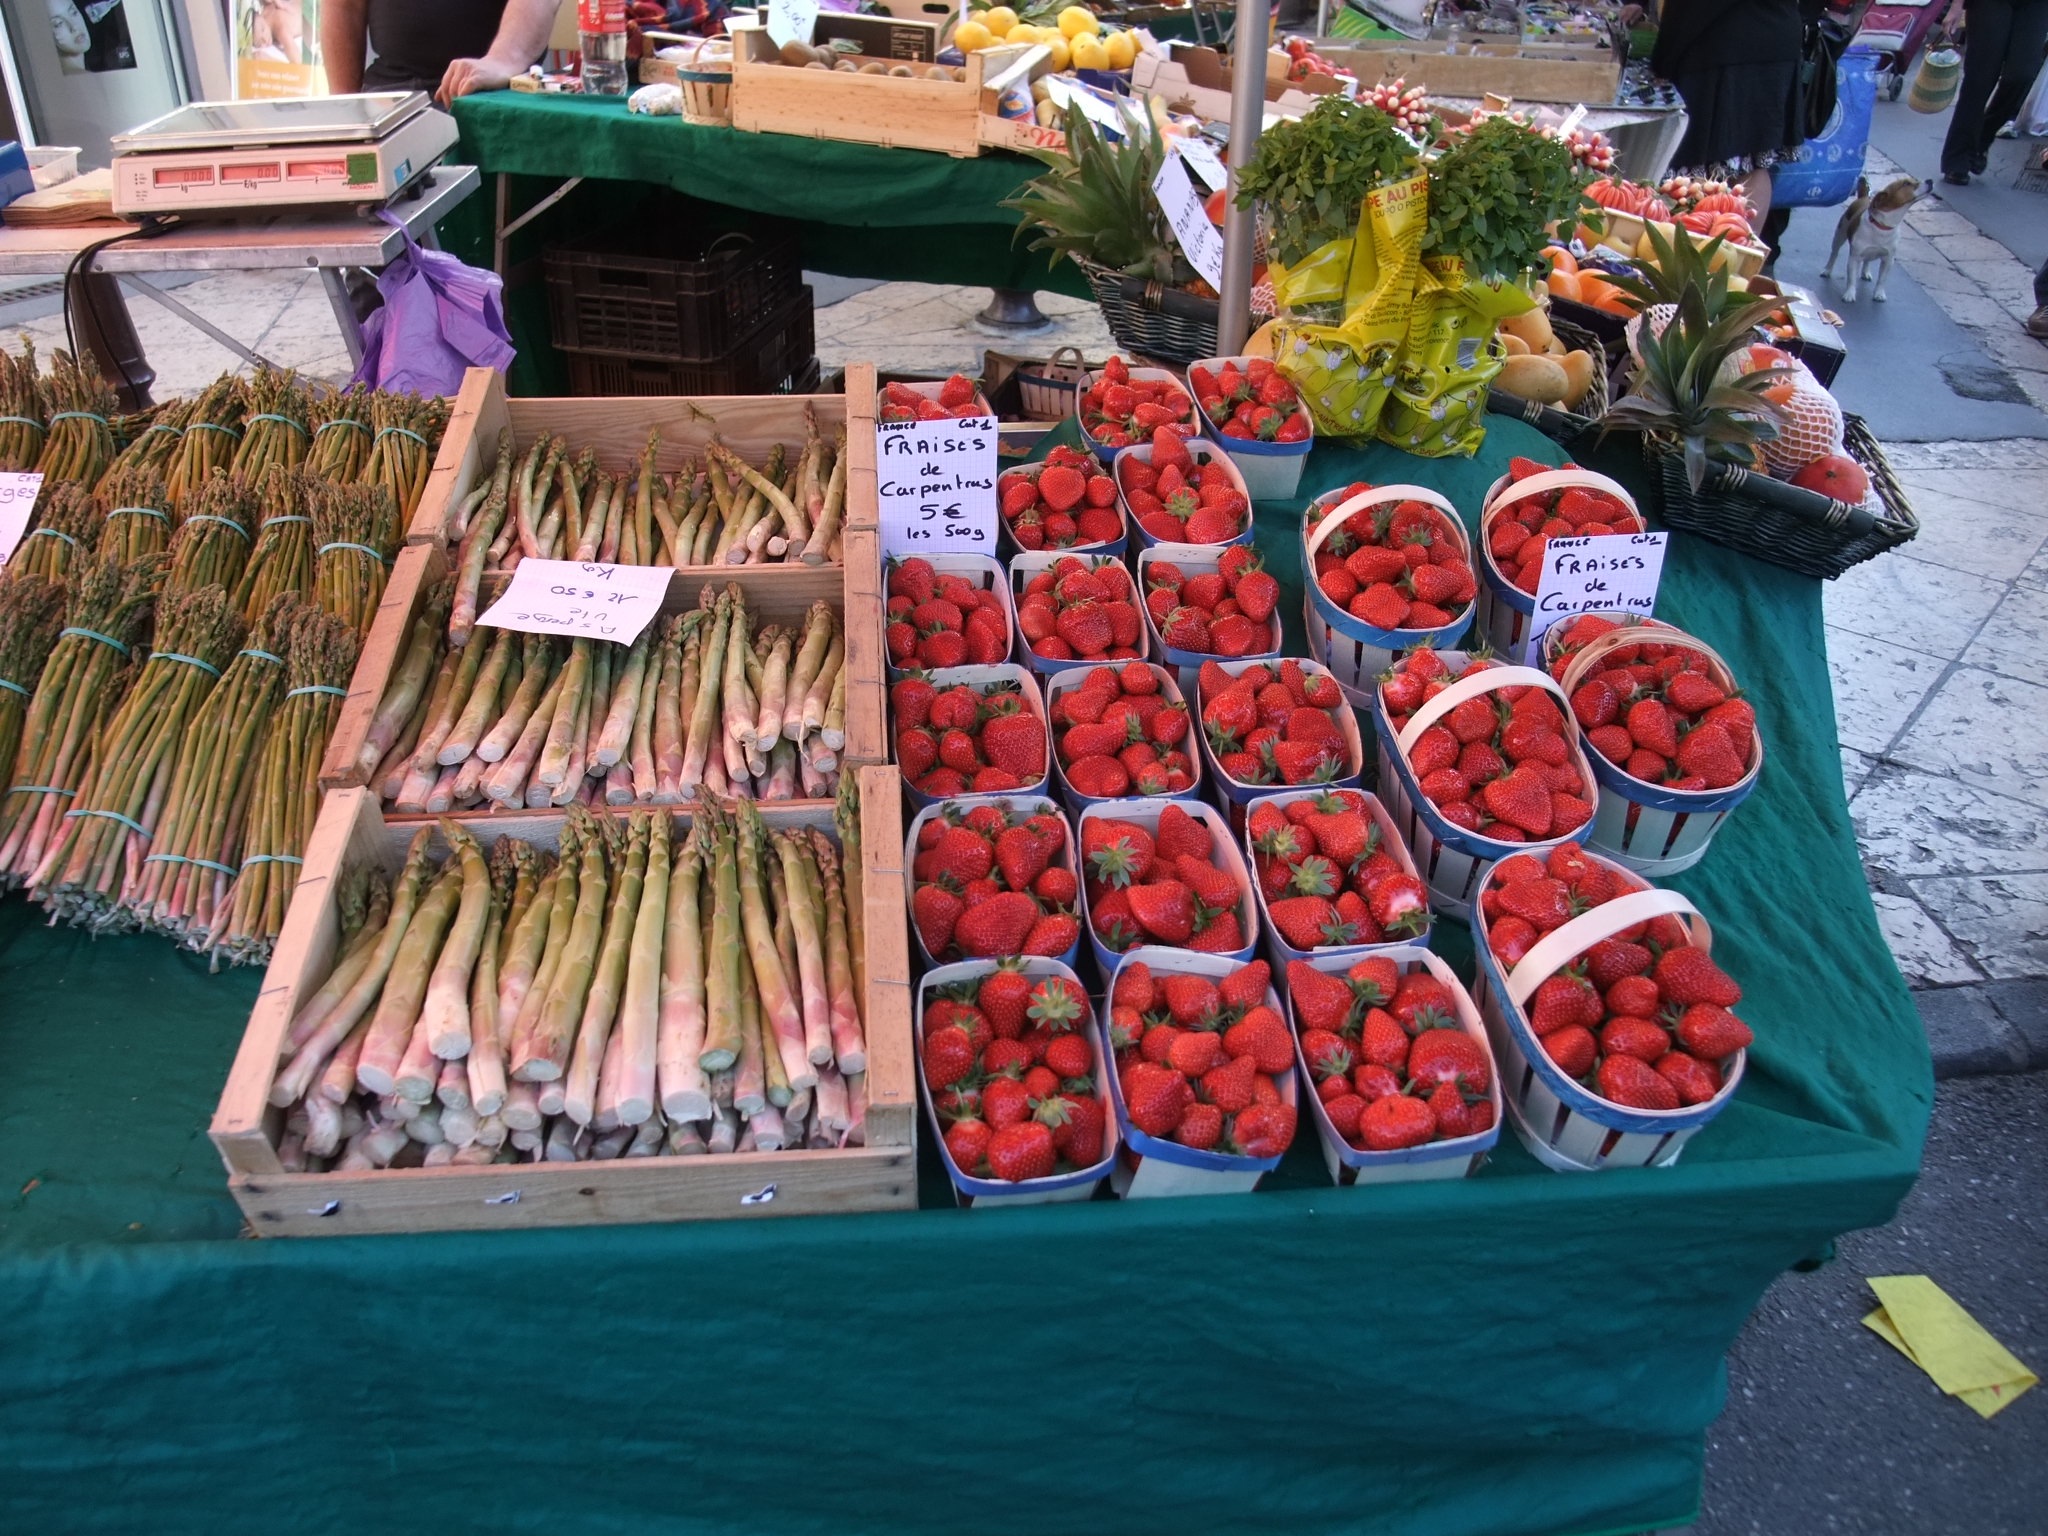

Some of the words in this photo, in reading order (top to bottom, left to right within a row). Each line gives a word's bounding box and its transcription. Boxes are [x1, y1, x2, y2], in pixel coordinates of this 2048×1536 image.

[1387, 186, 1407, 204] AU
[920, 462, 944, 476] de
[880, 474, 993, 498] Carpentras
[907, 527, 931, 539] les
[945, 524, 985, 540] 500g
[1585, 578, 1608, 592] de
[1540, 592, 1652, 612] Carpentras
